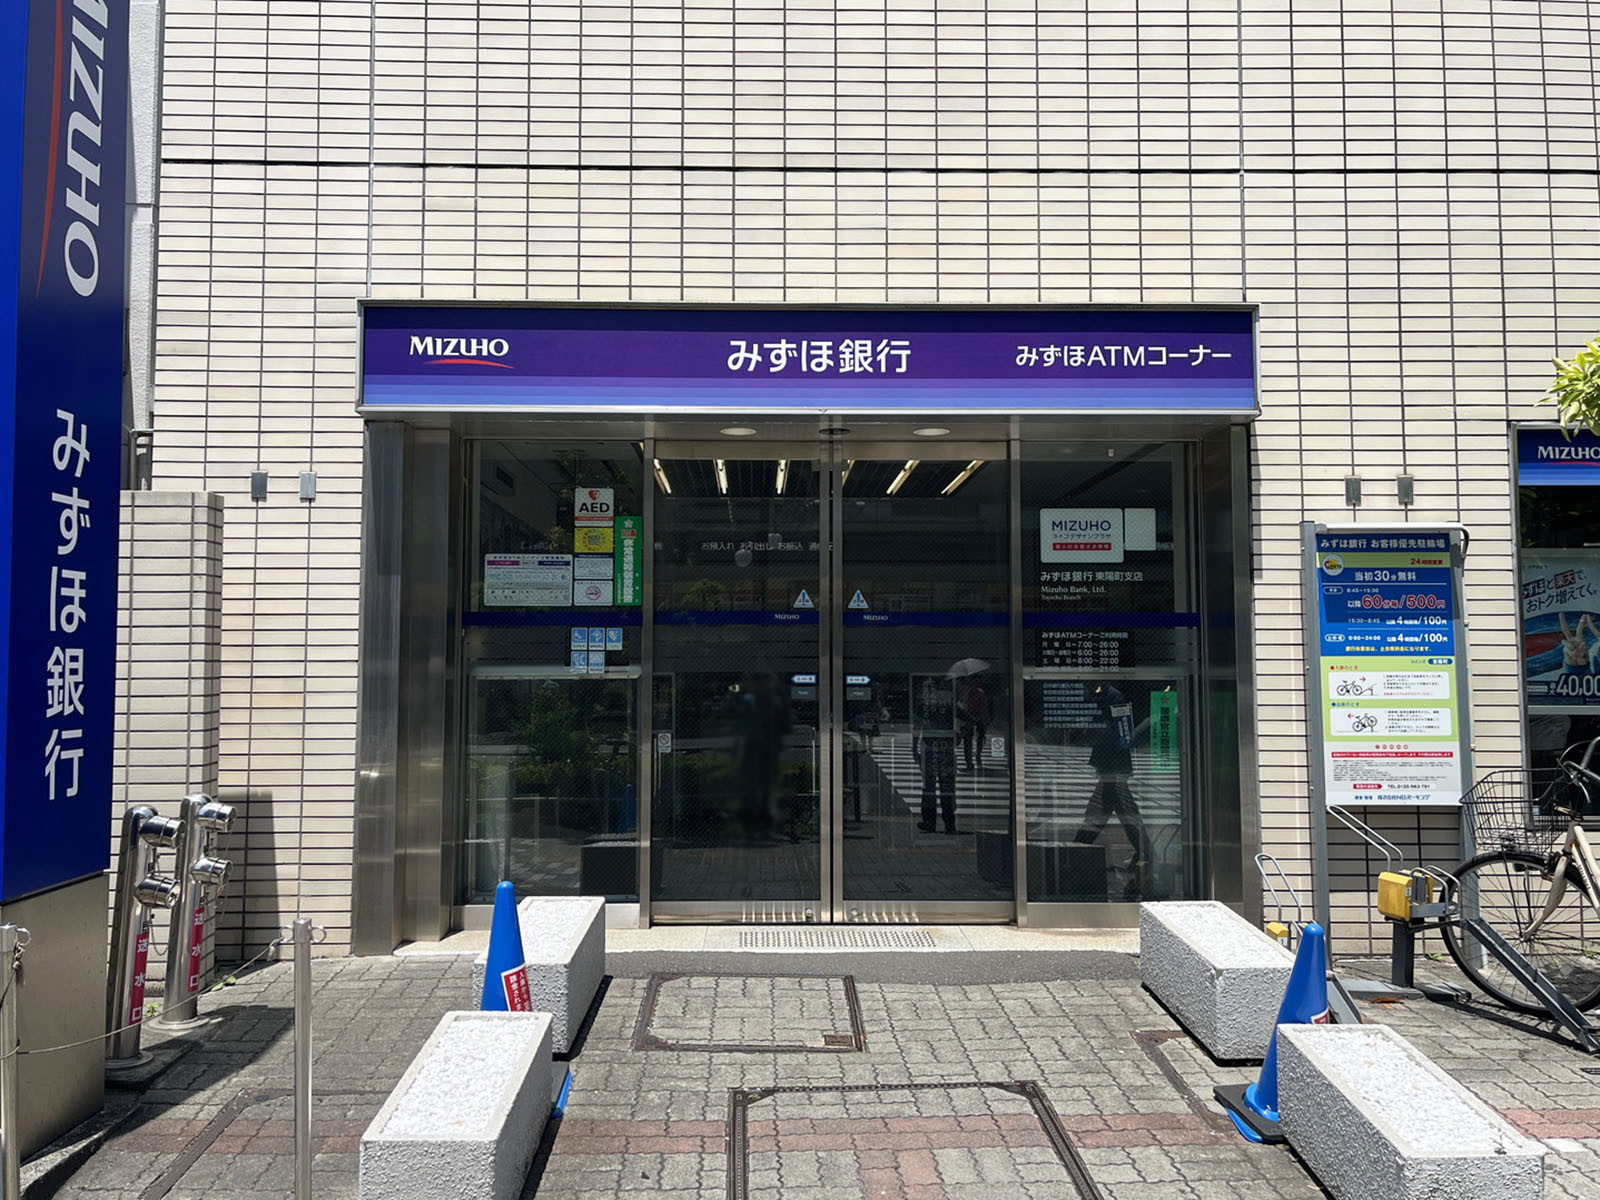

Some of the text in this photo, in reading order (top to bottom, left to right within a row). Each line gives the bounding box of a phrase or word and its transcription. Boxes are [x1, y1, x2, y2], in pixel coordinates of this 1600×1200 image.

[409, 335, 509, 357] MIZUHO
[727, 338, 911, 374] みずほ銀行
[1015, 344, 1232, 368] みずほATMコーナー
[578, 502, 610, 513] AED
[1051, 520, 1112, 531] MIZUHO
[1320, 538, 1367, 549] みずほ銀行
[1040, 571, 1094, 582] みずほ銀行
[1354, 570, 1417, 582] 当初30分無料
[1041, 585, 1069, 593] Mizuho
[44, 408, 91, 801] みずほ銀行
[189, 912, 205, 988] 送水口
[131, 937, 149, 1023] 送水口
